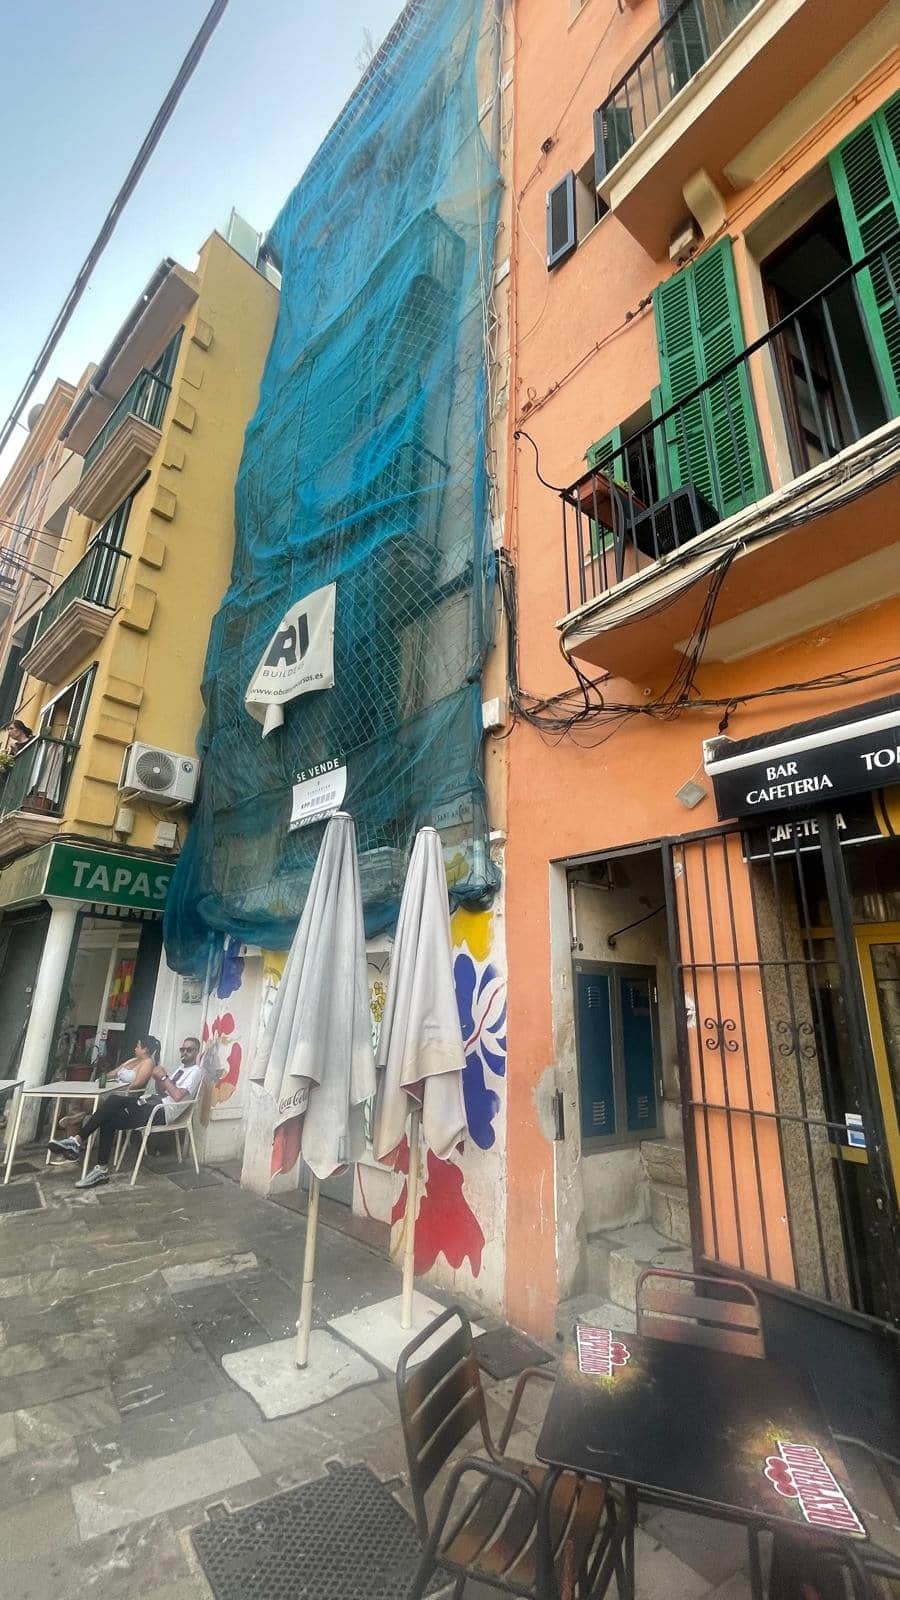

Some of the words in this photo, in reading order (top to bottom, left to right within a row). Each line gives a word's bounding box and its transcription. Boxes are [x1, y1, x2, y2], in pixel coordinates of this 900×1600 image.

[296, 771, 306, 783] SE
[308, 758, 340, 777] VENDE
[766, 761, 799, 781] BAR
[746, 774, 834, 805] CAFETERIA
[72, 860, 170, 900] TAPAS
